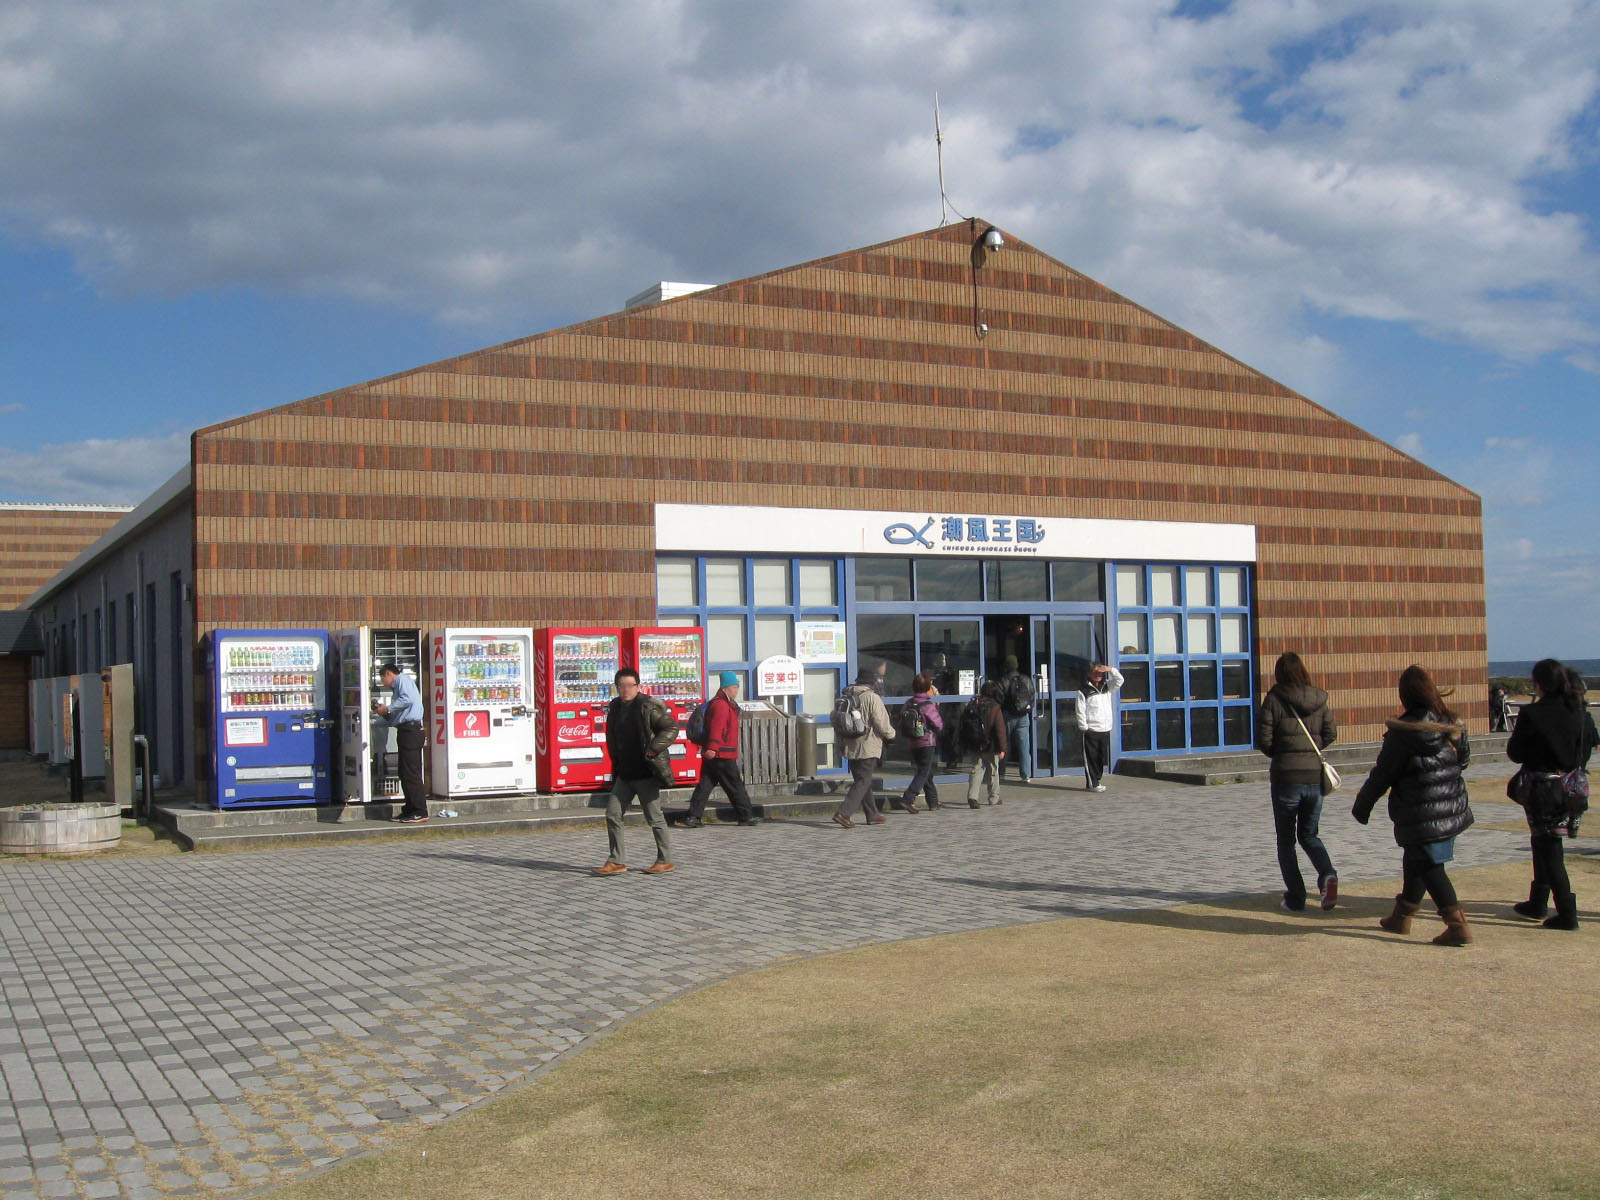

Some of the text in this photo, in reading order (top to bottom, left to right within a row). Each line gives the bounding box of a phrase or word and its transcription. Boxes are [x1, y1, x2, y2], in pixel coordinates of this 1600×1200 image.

[941, 517, 1045, 543] 潮風王国
[764, 672, 797, 683] 営業中
[435, 637, 445, 744] KIRIN
[463, 729, 481, 737] FIRE
[558, 724, 590, 736] Coca-Cola
